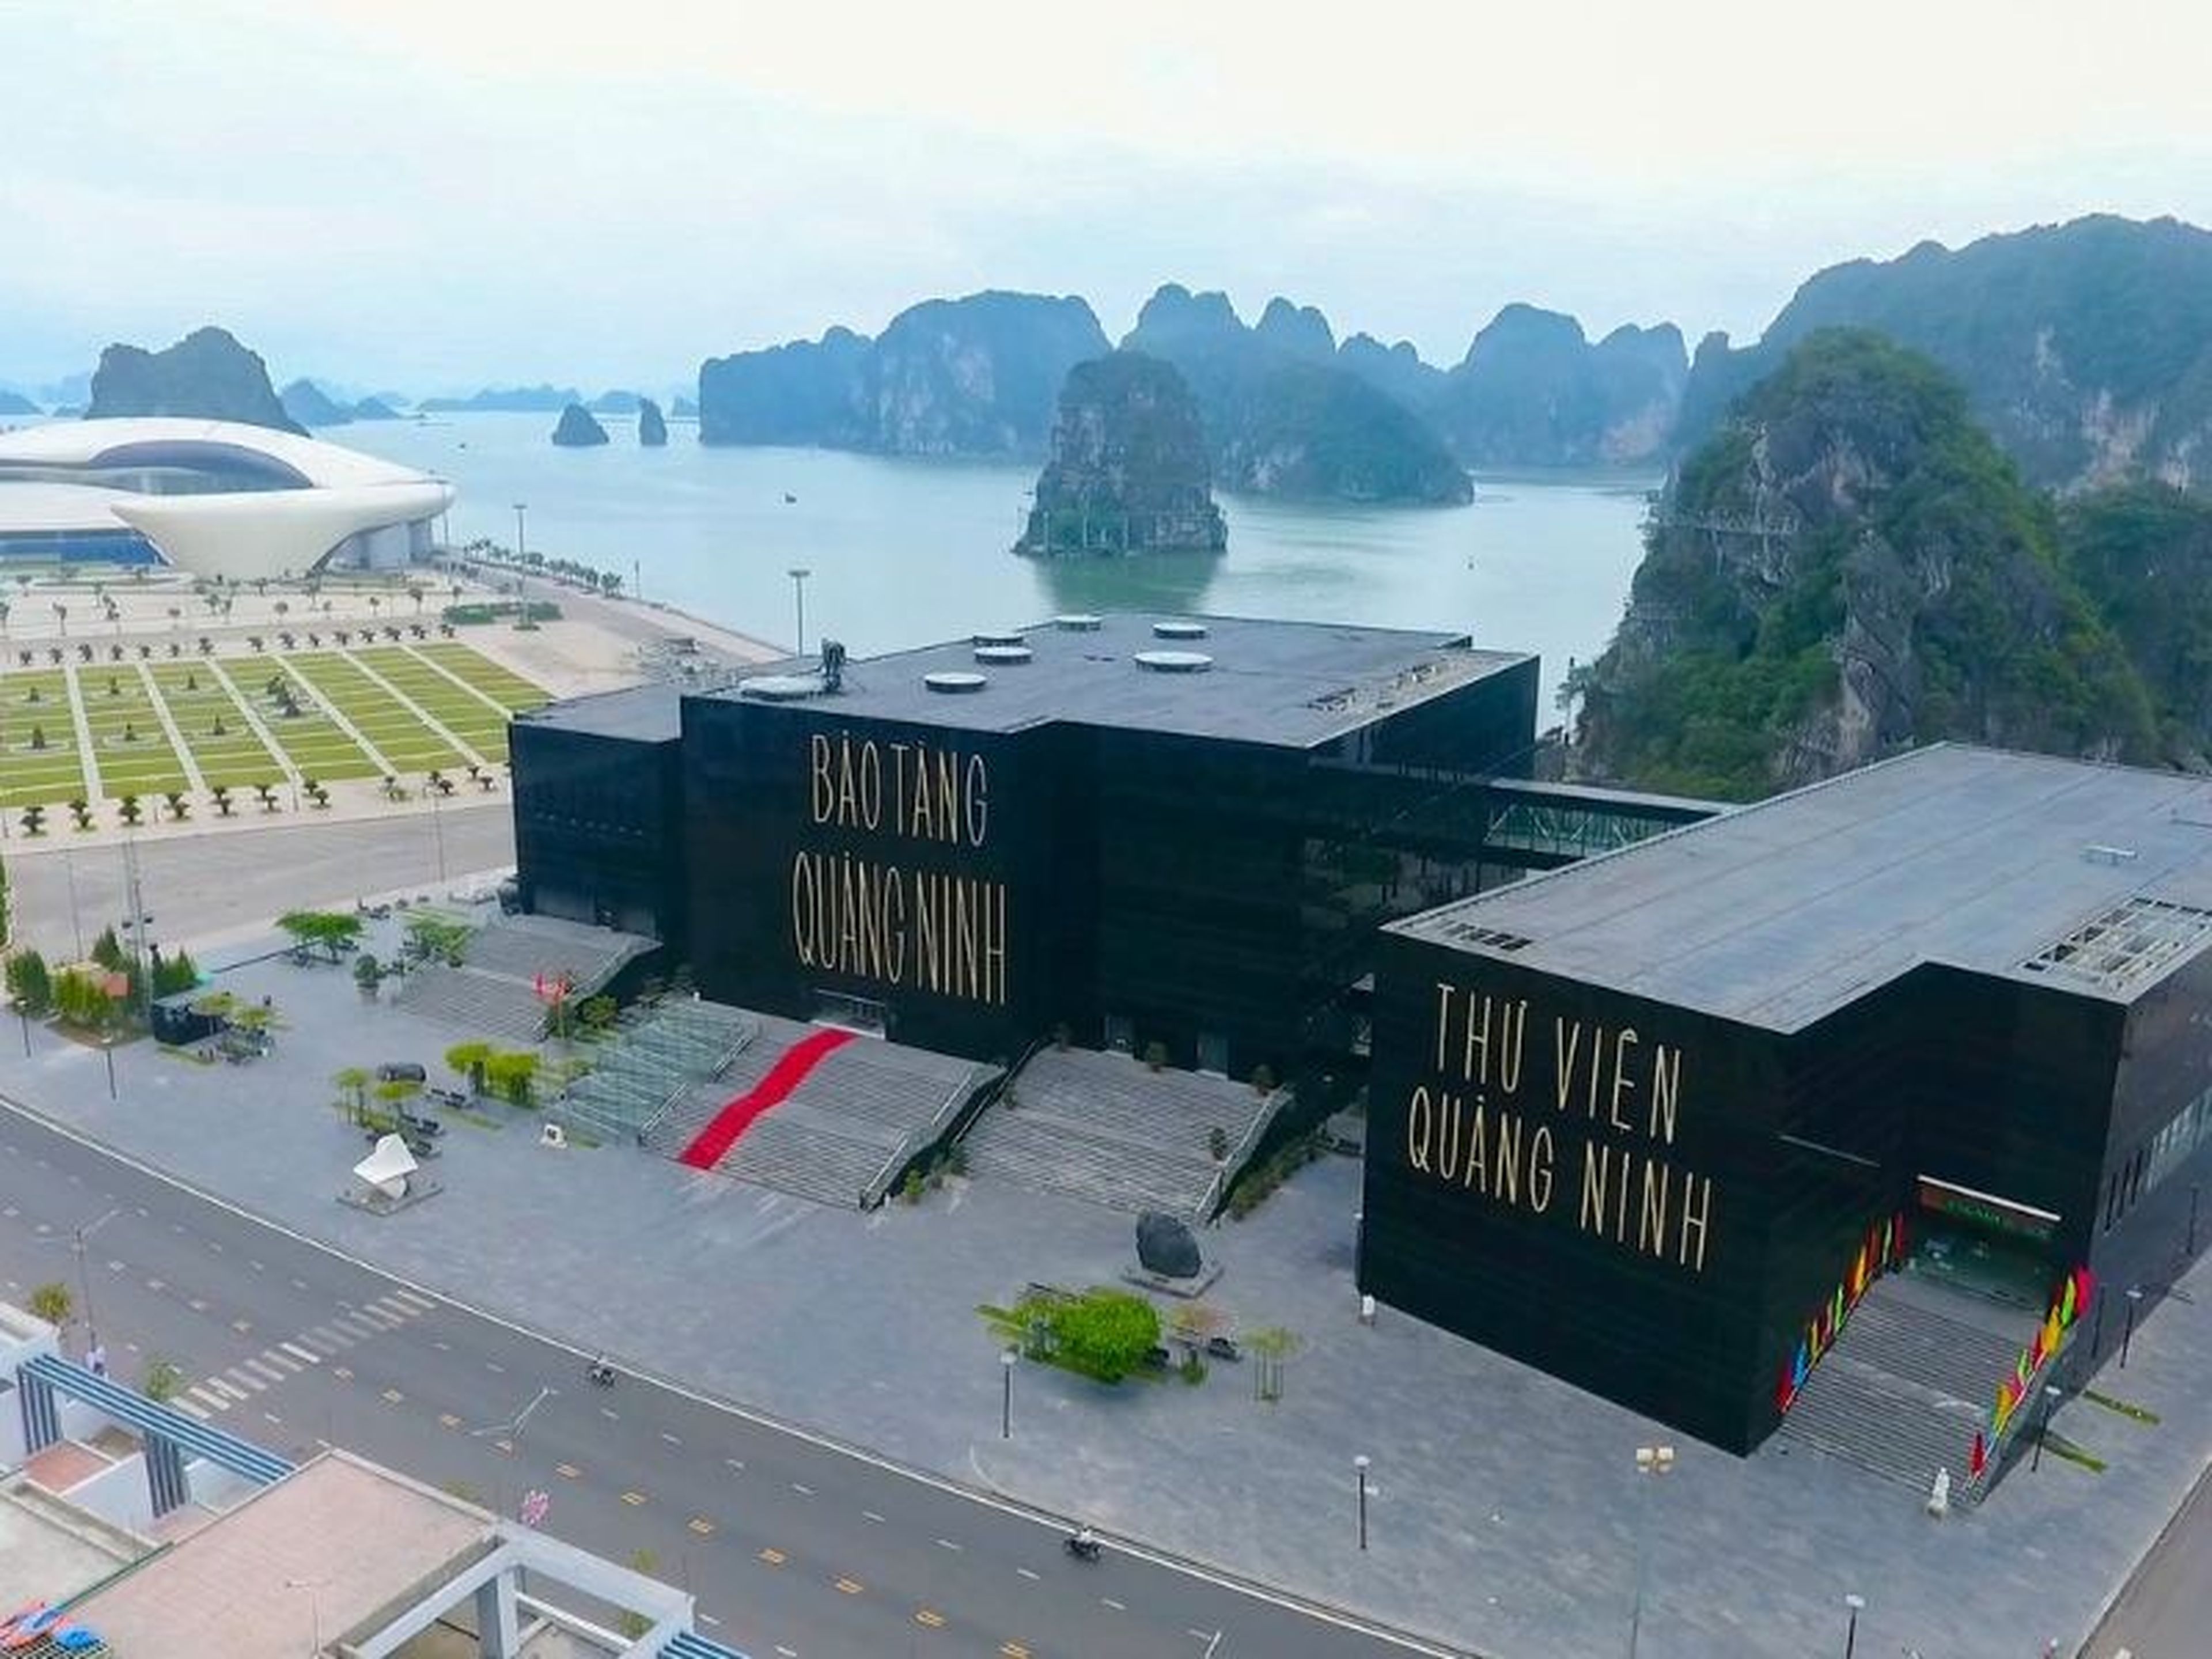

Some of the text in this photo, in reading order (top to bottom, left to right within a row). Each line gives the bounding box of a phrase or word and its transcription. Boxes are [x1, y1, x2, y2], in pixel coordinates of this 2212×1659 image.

[917, 870, 1004, 1005] NINH
[1437, 983, 1528, 1093] THƯ
[1581, 1141, 1710, 1272] NINH
